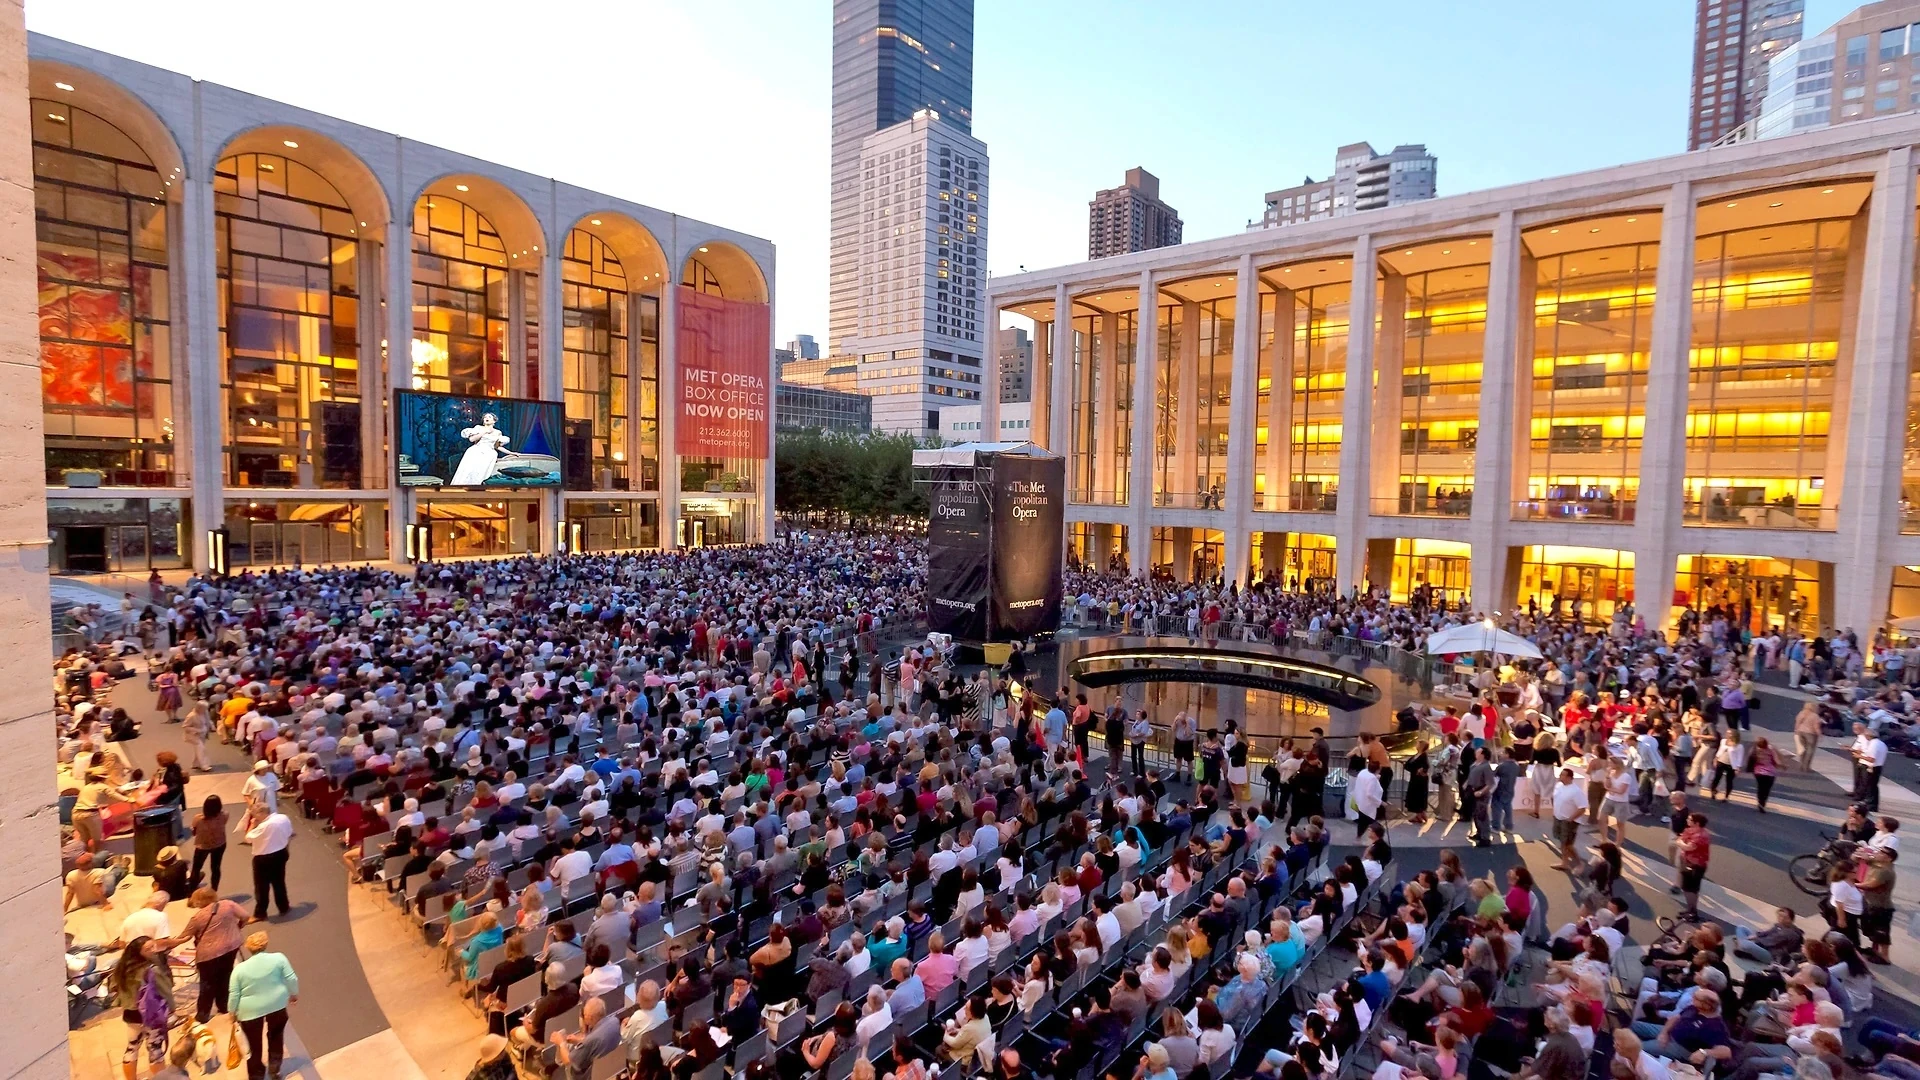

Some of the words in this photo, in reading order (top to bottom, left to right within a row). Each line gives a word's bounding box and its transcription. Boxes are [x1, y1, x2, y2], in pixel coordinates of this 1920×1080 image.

[686, 368, 717, 384] MET
[721, 373, 764, 389] OPERA
[685, 385, 716, 401] BOX
[720, 389, 764, 406] OFFICE
[685, 403, 724, 418] NOW
[727, 407, 764, 421] OPEN
[699, 427, 750, 438] 212.362.6000
[699, 438, 750, 449] metopera.org
[1012, 481, 1029, 493] The
[1030, 482, 1045, 493] Met
[939, 492, 979, 506] ropolitan
[1013, 493, 1048, 508] ropolitan
[938, 504, 966, 519] Opera
[1012, 506, 1038, 521] Opera
[935, 598, 976, 612] metopera.org
[1009, 598, 1044, 610] metopera.org
